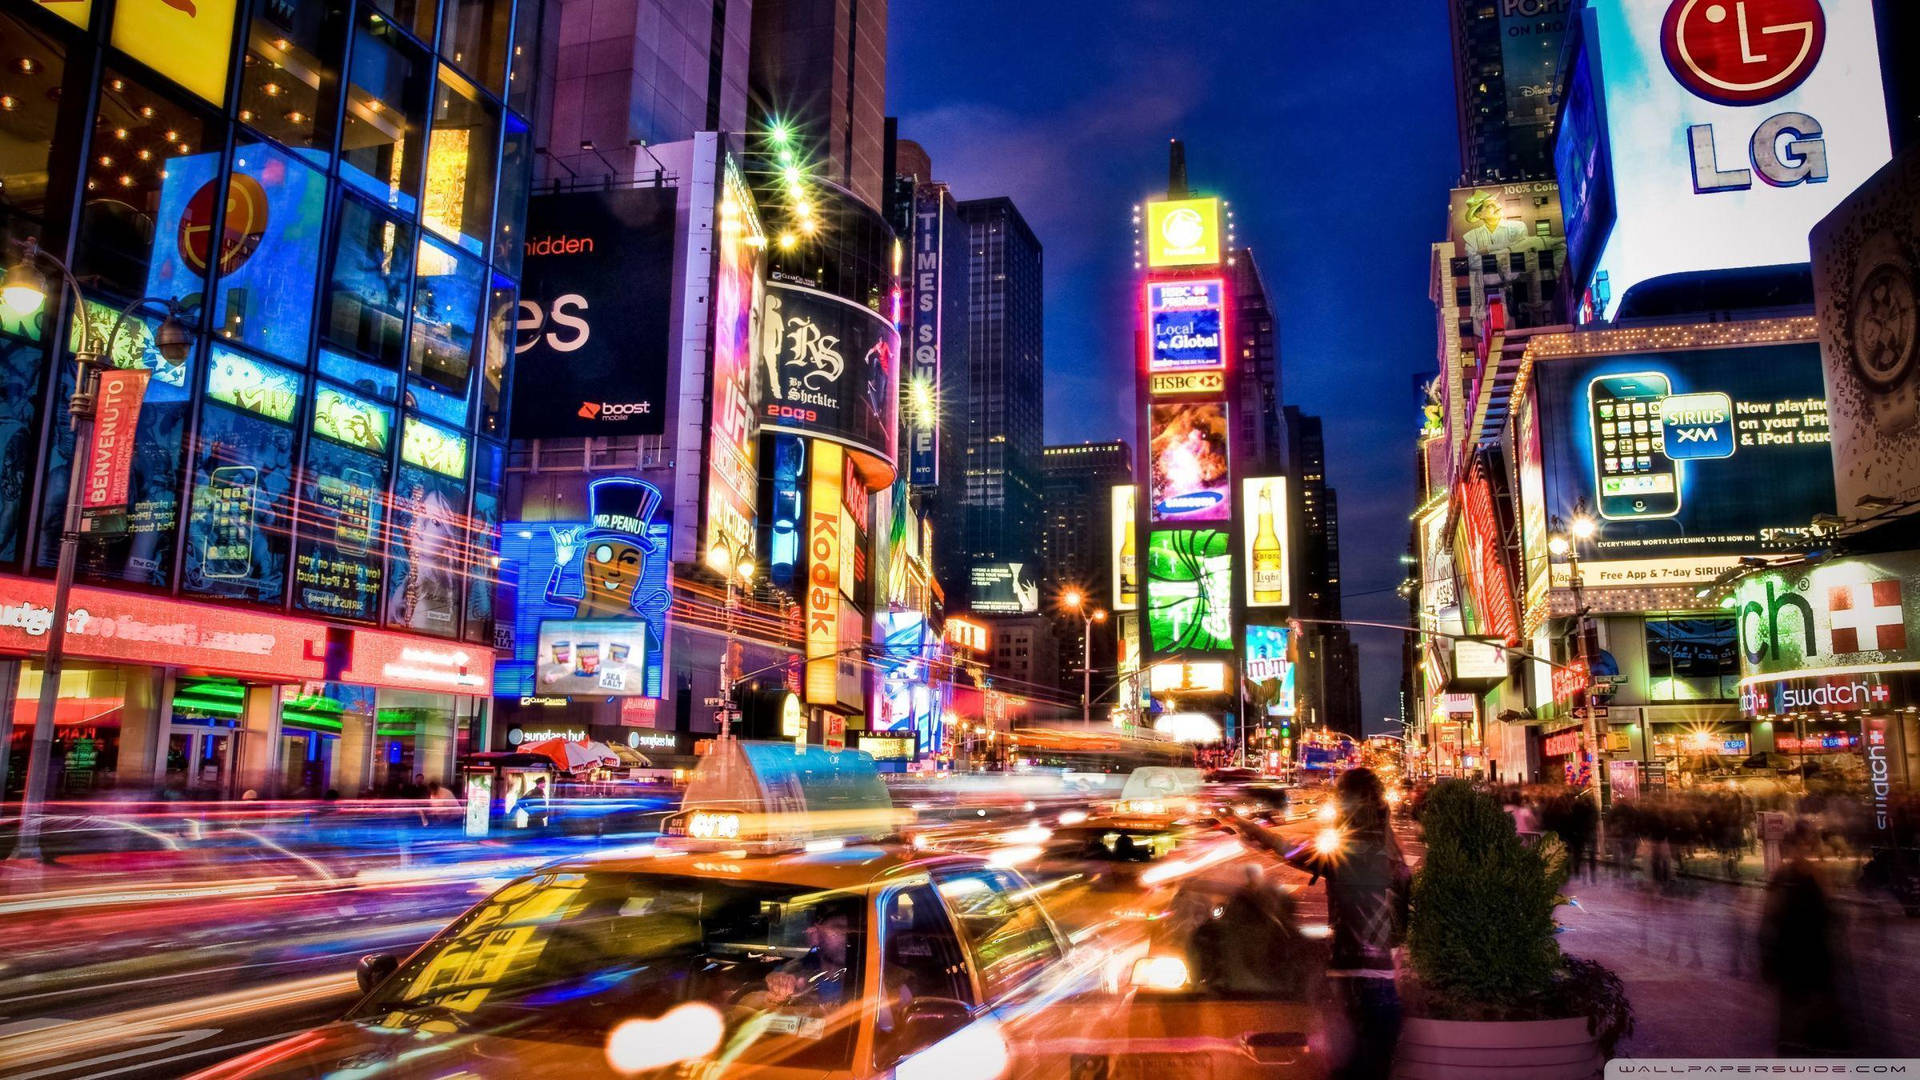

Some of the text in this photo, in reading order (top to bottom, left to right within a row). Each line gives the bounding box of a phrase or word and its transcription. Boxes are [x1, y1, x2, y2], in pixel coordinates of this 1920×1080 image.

[1687, 111, 1829, 195] LG
[915, 212, 937, 453] TIMES SQUE
[1155, 321, 1195, 336] Local
[1169, 332, 1219, 349] Global
[784, 315, 845, 391] RS
[788, 376, 802, 389] By
[1153, 376, 1197, 390] HSBC
[787, 387, 837, 409] Sheckler
[602, 401, 650, 415] boost
[767, 404, 817, 423] 2009
[1737, 400, 1772, 415] Now
[1668, 408, 1725, 426] SIRIUS
[1738, 417, 1759, 430] on
[1762, 415, 1800, 431] your
[91, 379, 124, 503] BENVENUTO
[1676, 427, 1718, 444] XM
[1740, 432, 1754, 446] &
[1758, 430, 1793, 445] iPod
[915, 465, 932, 474] NYC
[593, 514, 646, 537] MR. PEANUT
[1597, 535, 1755, 548] EVERYTHING WORTH LISTENING TO IS NOW ON
[811, 511, 838, 640] Kodak
[1600, 571, 1623, 581] Free
[1626, 569, 1647, 581] App
[1650, 570, 1657, 578] &
[1662, 567, 1691, 579] 7-day
[601, 678, 623, 688] SALT
[605, 672, 621, 681] SEA
[1783, 681, 1869, 708] swatch
[568, 728, 586, 742] hut
[640, 733, 676, 749] sunglass hut
[858, 730, 916, 738] MARQUIS
[671, 818, 684, 827] OFF
[668, 827, 685, 835] DUTY
